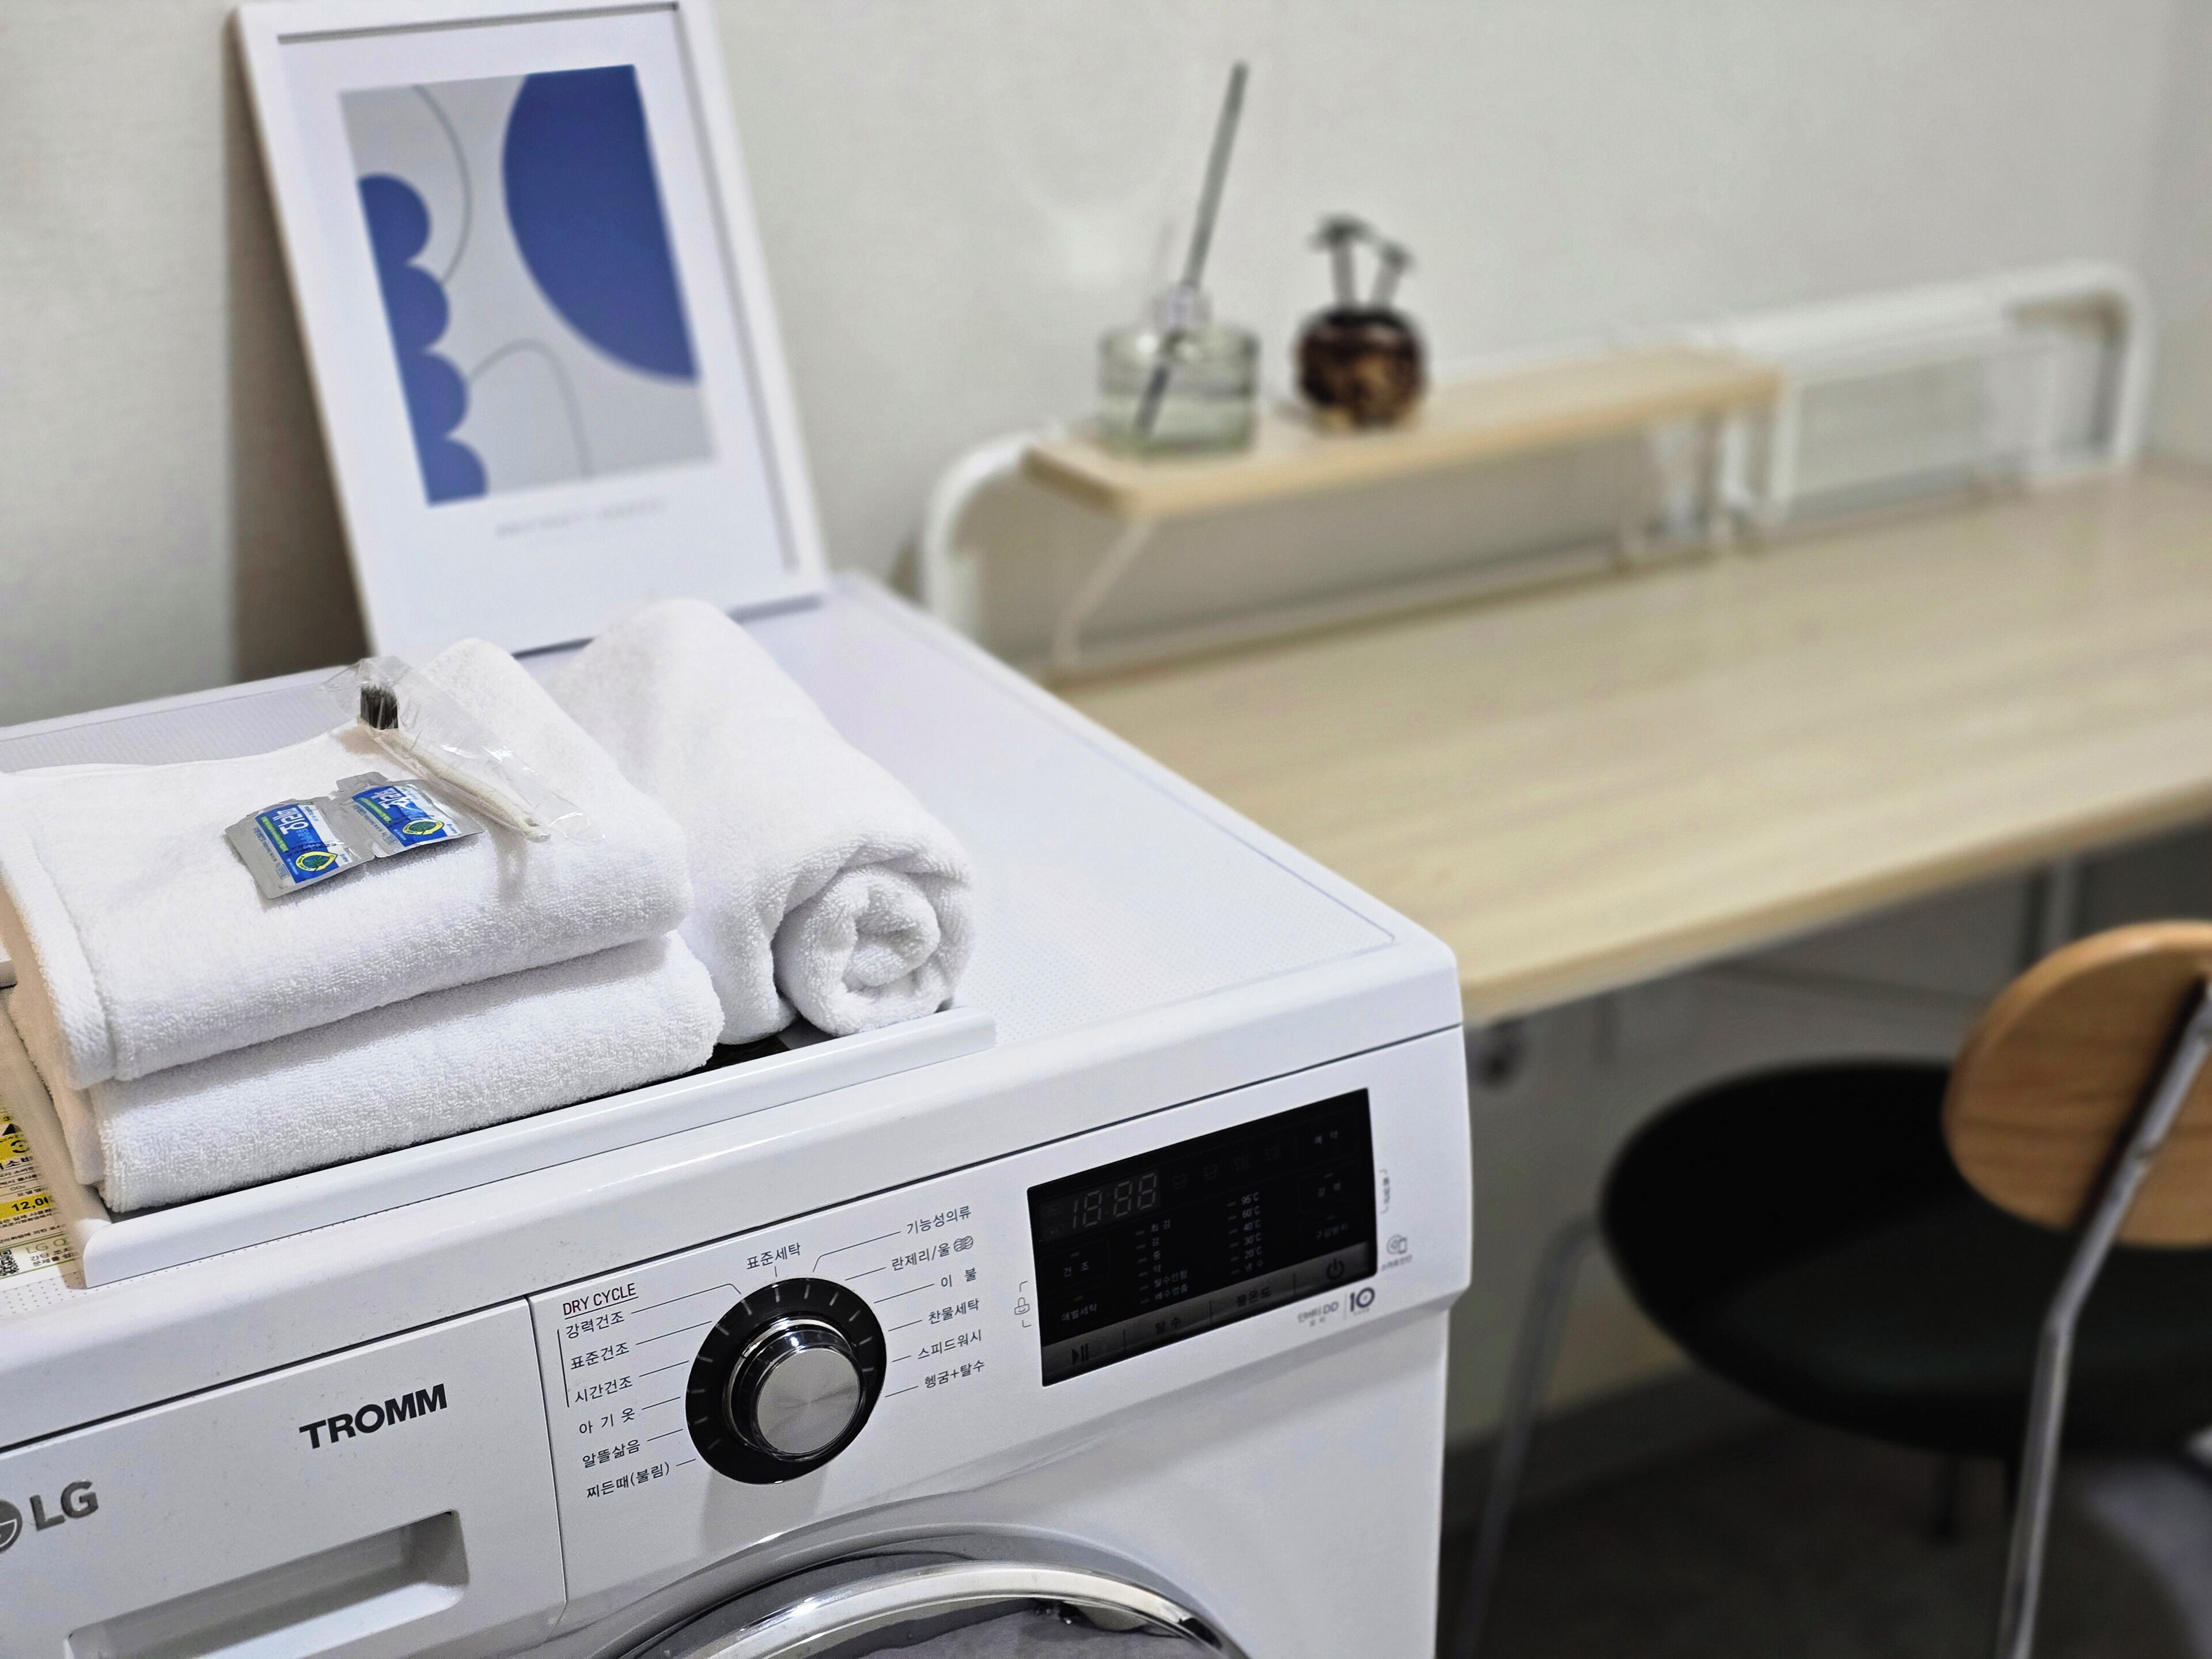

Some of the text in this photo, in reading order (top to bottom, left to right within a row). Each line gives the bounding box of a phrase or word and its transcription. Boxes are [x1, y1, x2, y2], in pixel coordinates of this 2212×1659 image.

[272, 807, 309, 835] 페리오
[907, 1206, 972, 1234] 기능성의류
[25, 1243, 49, 1254] LG
[747, 1242, 801, 1270] 표준세탁
[892, 1243, 950, 1271] 란제리/울
[563, 1282, 636, 1316] DRY CYCLE
[928, 1298, 979, 1324] 찬물세탁
[566, 1311, 624, 1339] 강력건조
[571, 1342, 629, 1370] 표준건조
[917, 1329, 982, 1359] 스피드워시
[925, 1360, 985, 1388] 헹굼+탈수
[575, 1376, 632, 1403] 시간건조
[298, 1383, 448, 1449] TROMM
[582, 1440, 640, 1468] 알뜰삶음
[586, 1462, 669, 1498] 찌든때(불림)
[29, 1479, 99, 1532] LG
